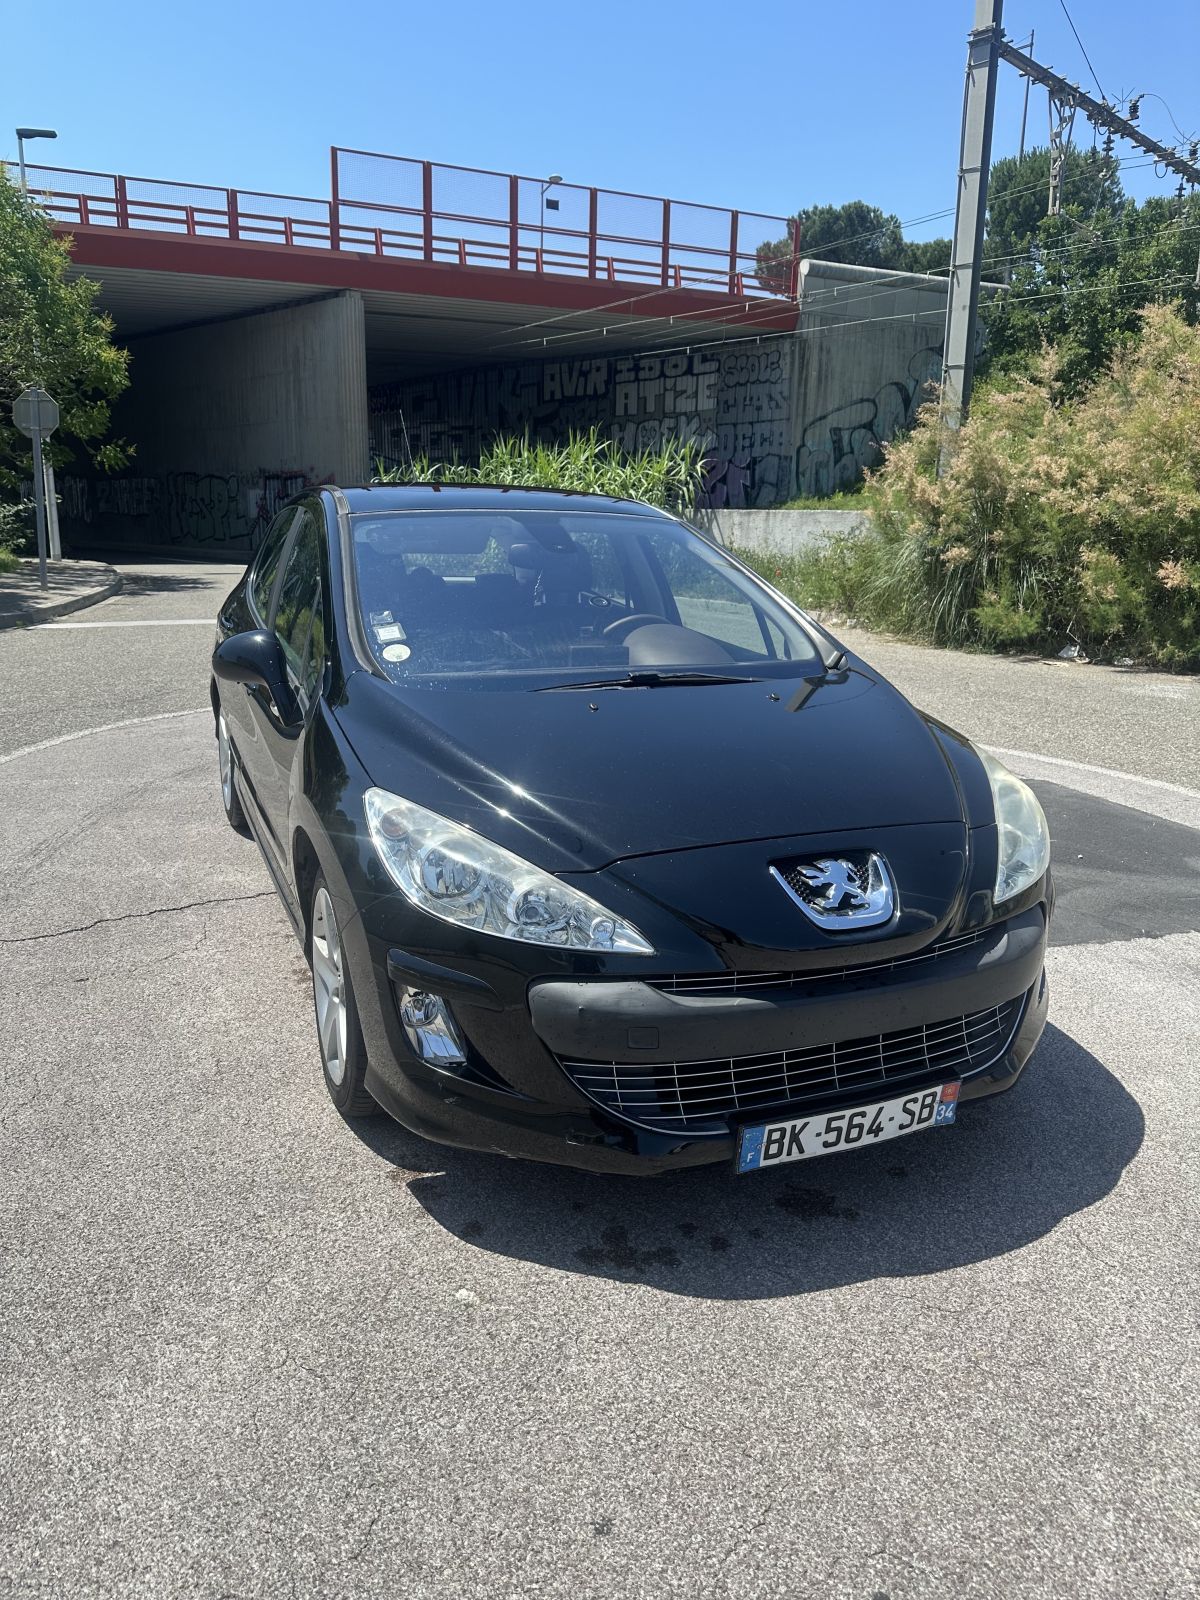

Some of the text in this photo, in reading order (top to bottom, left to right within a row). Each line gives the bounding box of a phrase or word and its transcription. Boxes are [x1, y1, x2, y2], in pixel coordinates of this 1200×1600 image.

[936, 1103, 955, 1120] 34
[763, 1091, 938, 1161] BK-564-SB
[746, 1151, 755, 1163] F
